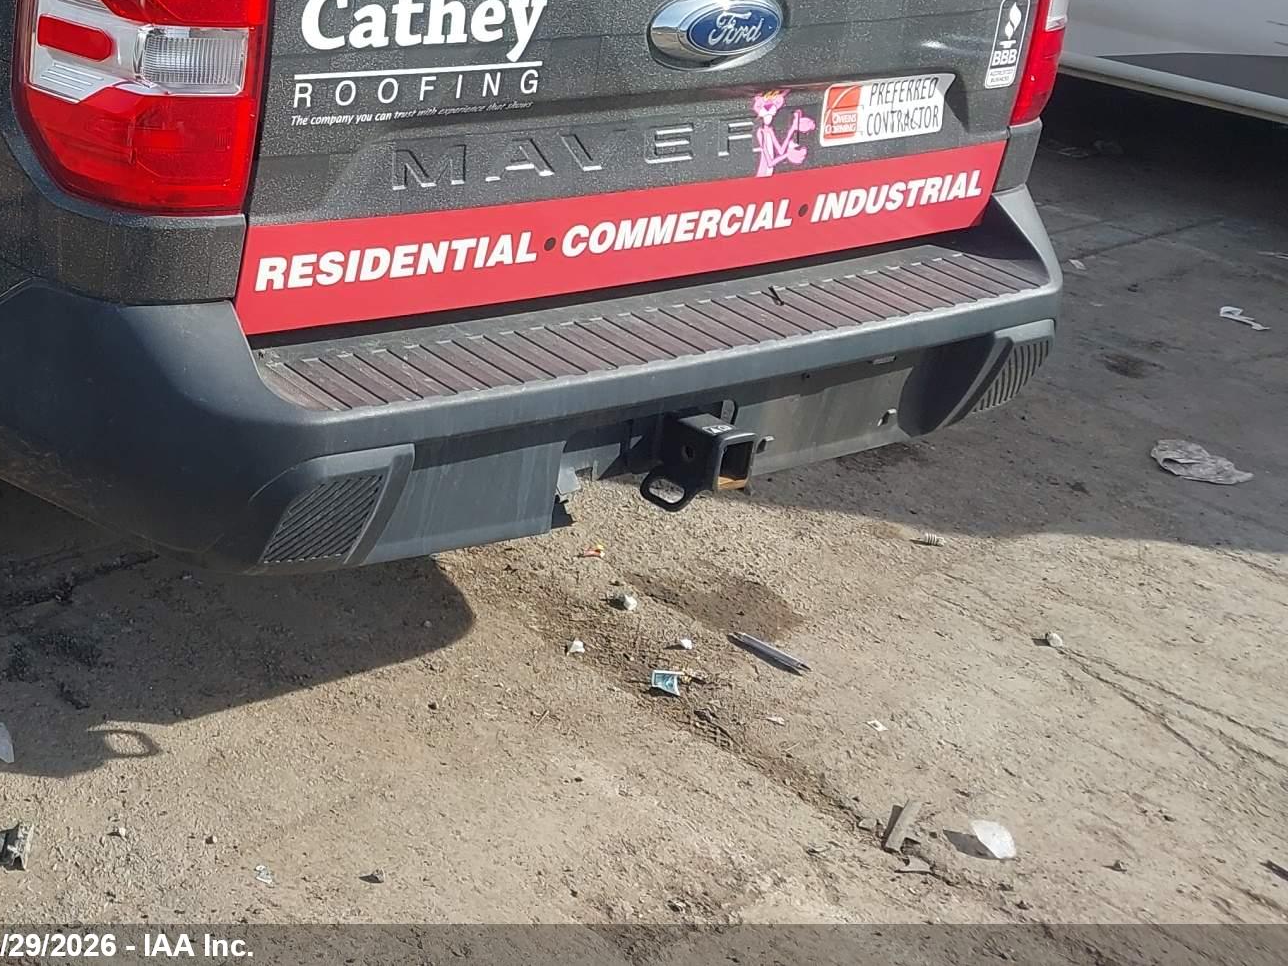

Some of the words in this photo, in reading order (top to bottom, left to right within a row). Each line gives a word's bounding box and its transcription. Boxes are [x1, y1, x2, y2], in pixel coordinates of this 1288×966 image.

[708, 11, 765, 46] Ford
[991, 48, 1018, 66] BBB
[292, 69, 539, 109] ROOFING
[869, 77, 939, 106] PREFERRED
[291, 115, 308, 126] The
[310, 114, 353, 126] company
[356, 113, 373, 125] you
[375, 112, 392, 122] can
[866, 105, 939, 136] CONTRACTOR
[392, 117, 800, 191] MAVER
[255, 230, 538, 292] RESIDENTIAL
[561, 200, 794, 258] COMMERCIAL
[809, 170, 983, 223] INDUSTRIAL
